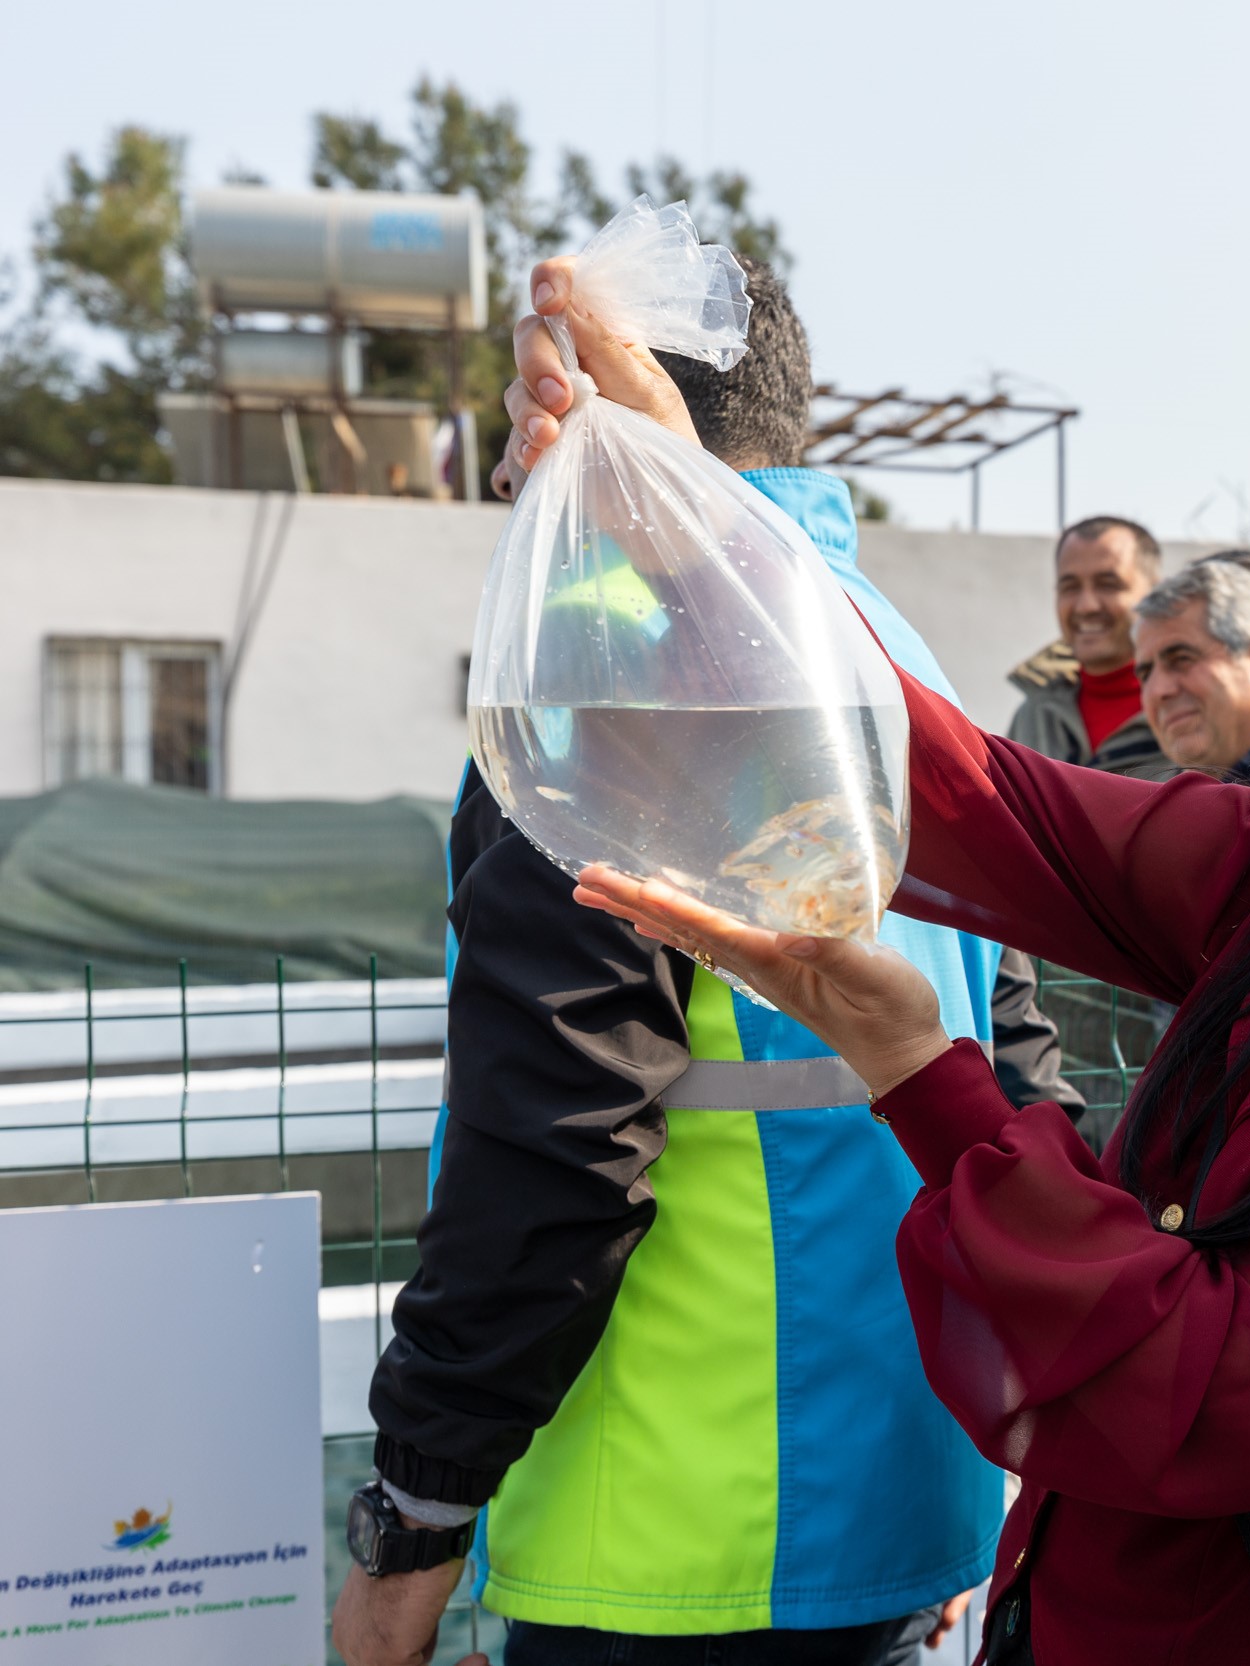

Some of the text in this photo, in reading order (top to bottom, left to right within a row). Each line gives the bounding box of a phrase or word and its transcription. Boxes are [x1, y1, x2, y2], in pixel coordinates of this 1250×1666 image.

[16, 1565, 145, 1590] Değişikliğine
[152, 1551, 268, 1574] Adaptasyon
[273, 1543, 307, 1562] İçin
[12, 1627, 21, 1637] A
[26, 1623, 63, 1635] Move
[67, 1619, 89, 1631] For
[95, 1610, 170, 1626] Adaptation
[174, 1605, 190, 1617] To
[194, 1601, 244, 1615] Climate
[249, 1594, 298, 1608] Change
[70, 1580, 204, 1608] Harekete Geç
